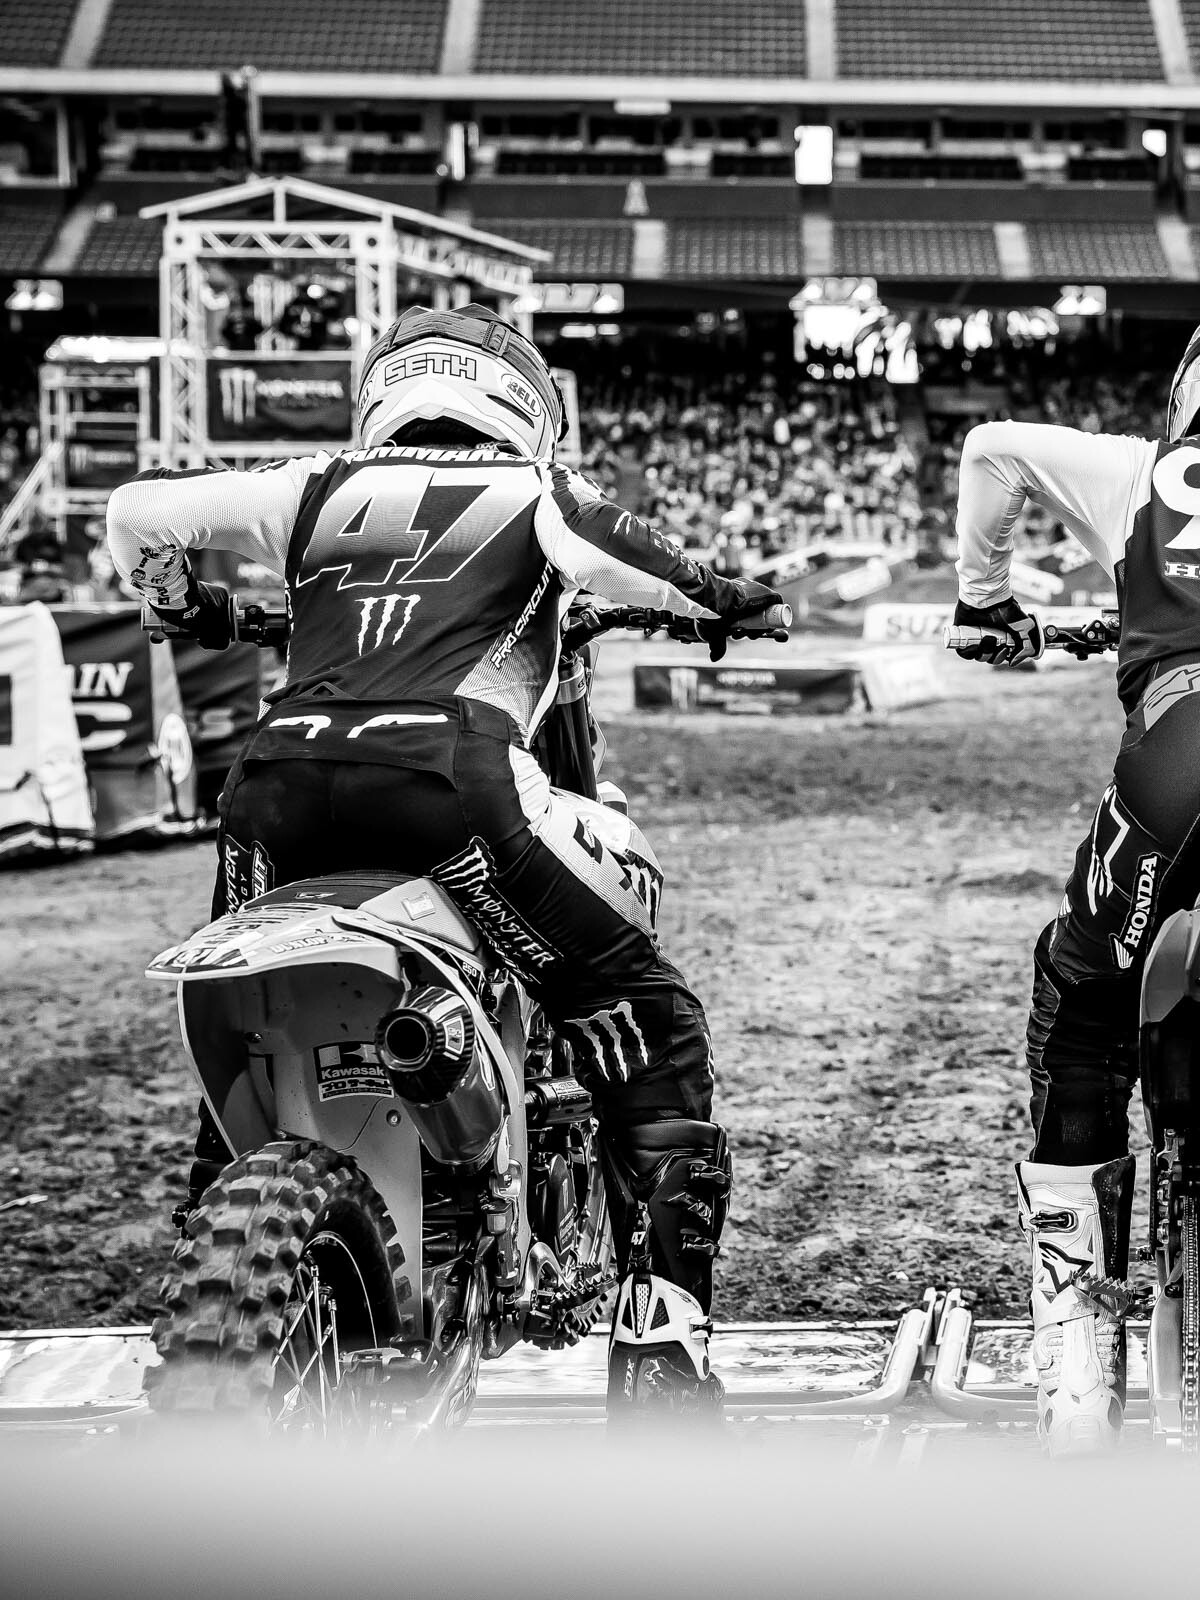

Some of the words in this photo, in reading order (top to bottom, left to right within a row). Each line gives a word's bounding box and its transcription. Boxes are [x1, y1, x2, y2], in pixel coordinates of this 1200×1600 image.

[384, 352, 477, 387] SETH
[507, 376, 538, 414] BELL
[297, 465, 544, 588] 47
[491, 632, 517, 668] PRO
[1123, 855, 1158, 948] HONDA
[467, 884, 556, 968] MONSTER
[271, 935, 328, 954] DUNLOP
[462, 961, 477, 978] 250
[321, 1065, 386, 1080] Kawasak
[631, 1231, 646, 1246] 47
